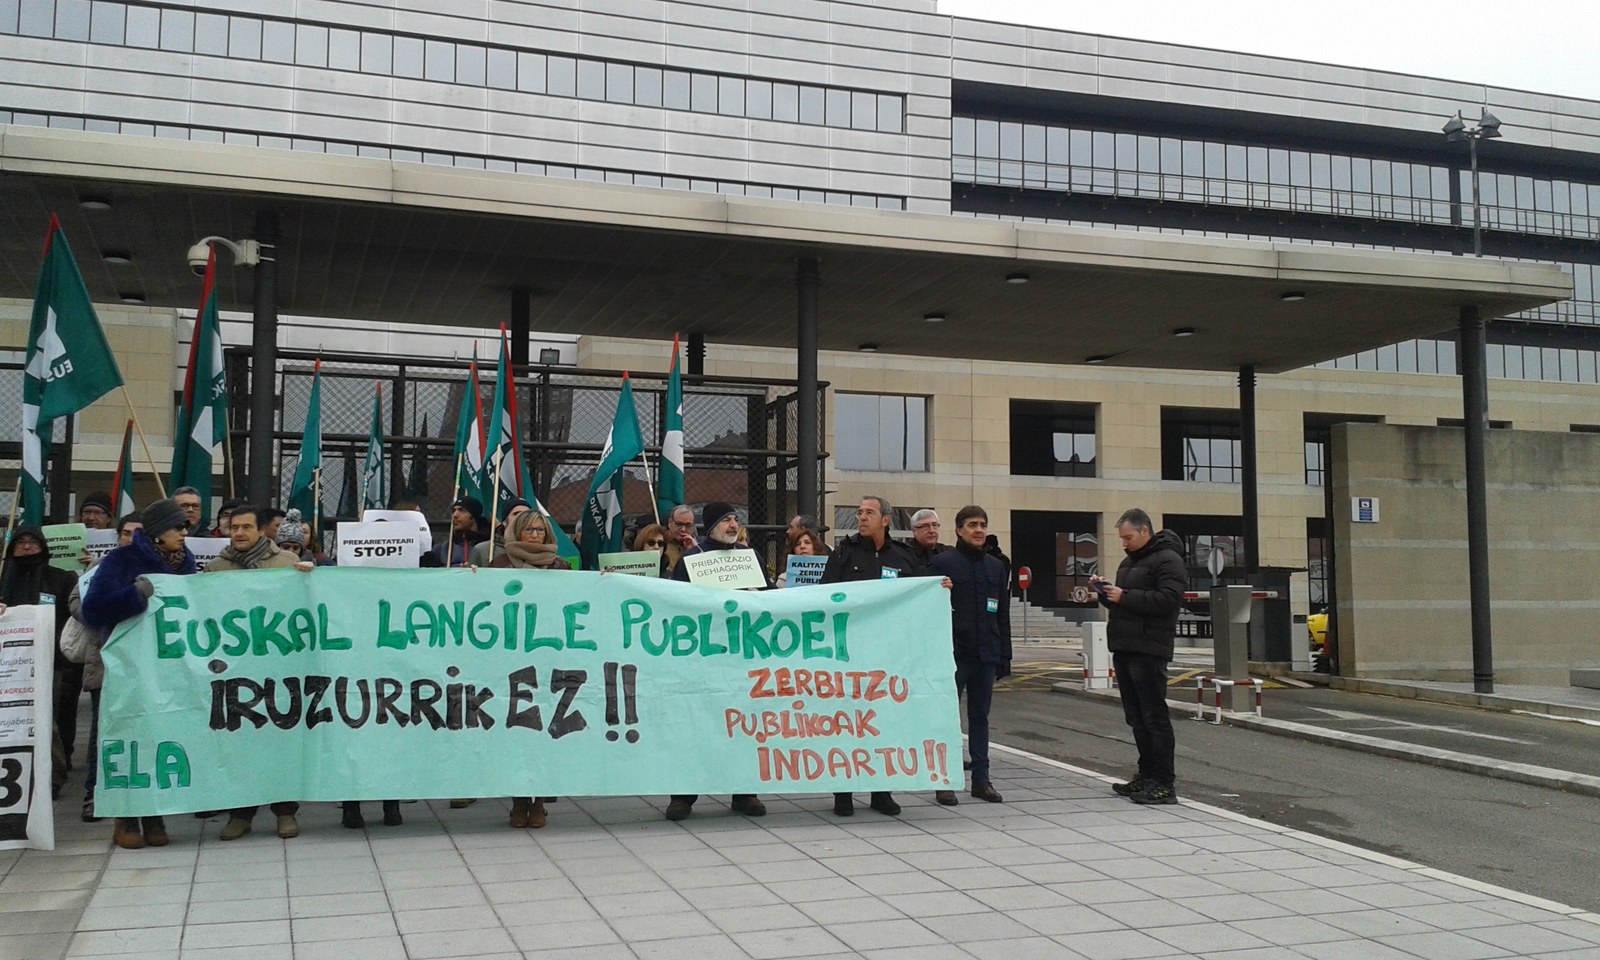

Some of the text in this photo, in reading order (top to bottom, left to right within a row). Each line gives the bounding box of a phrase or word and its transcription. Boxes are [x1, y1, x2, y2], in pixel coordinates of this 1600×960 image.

[343, 538, 414, 546] PREKARIETATEARI
[354, 546, 403, 557] STOP!
[691, 555, 752, 569] PRIBATIZAZIO
[696, 564, 754, 578] GEHIAGORIK
[718, 574, 738, 582] EZ!!!
[155, 595, 353, 659] EUSKAL
[376, 579, 598, 653] LANGILE
[747, 667, 909, 703] ZERBITZU
[102, 739, 192, 790] ELA
